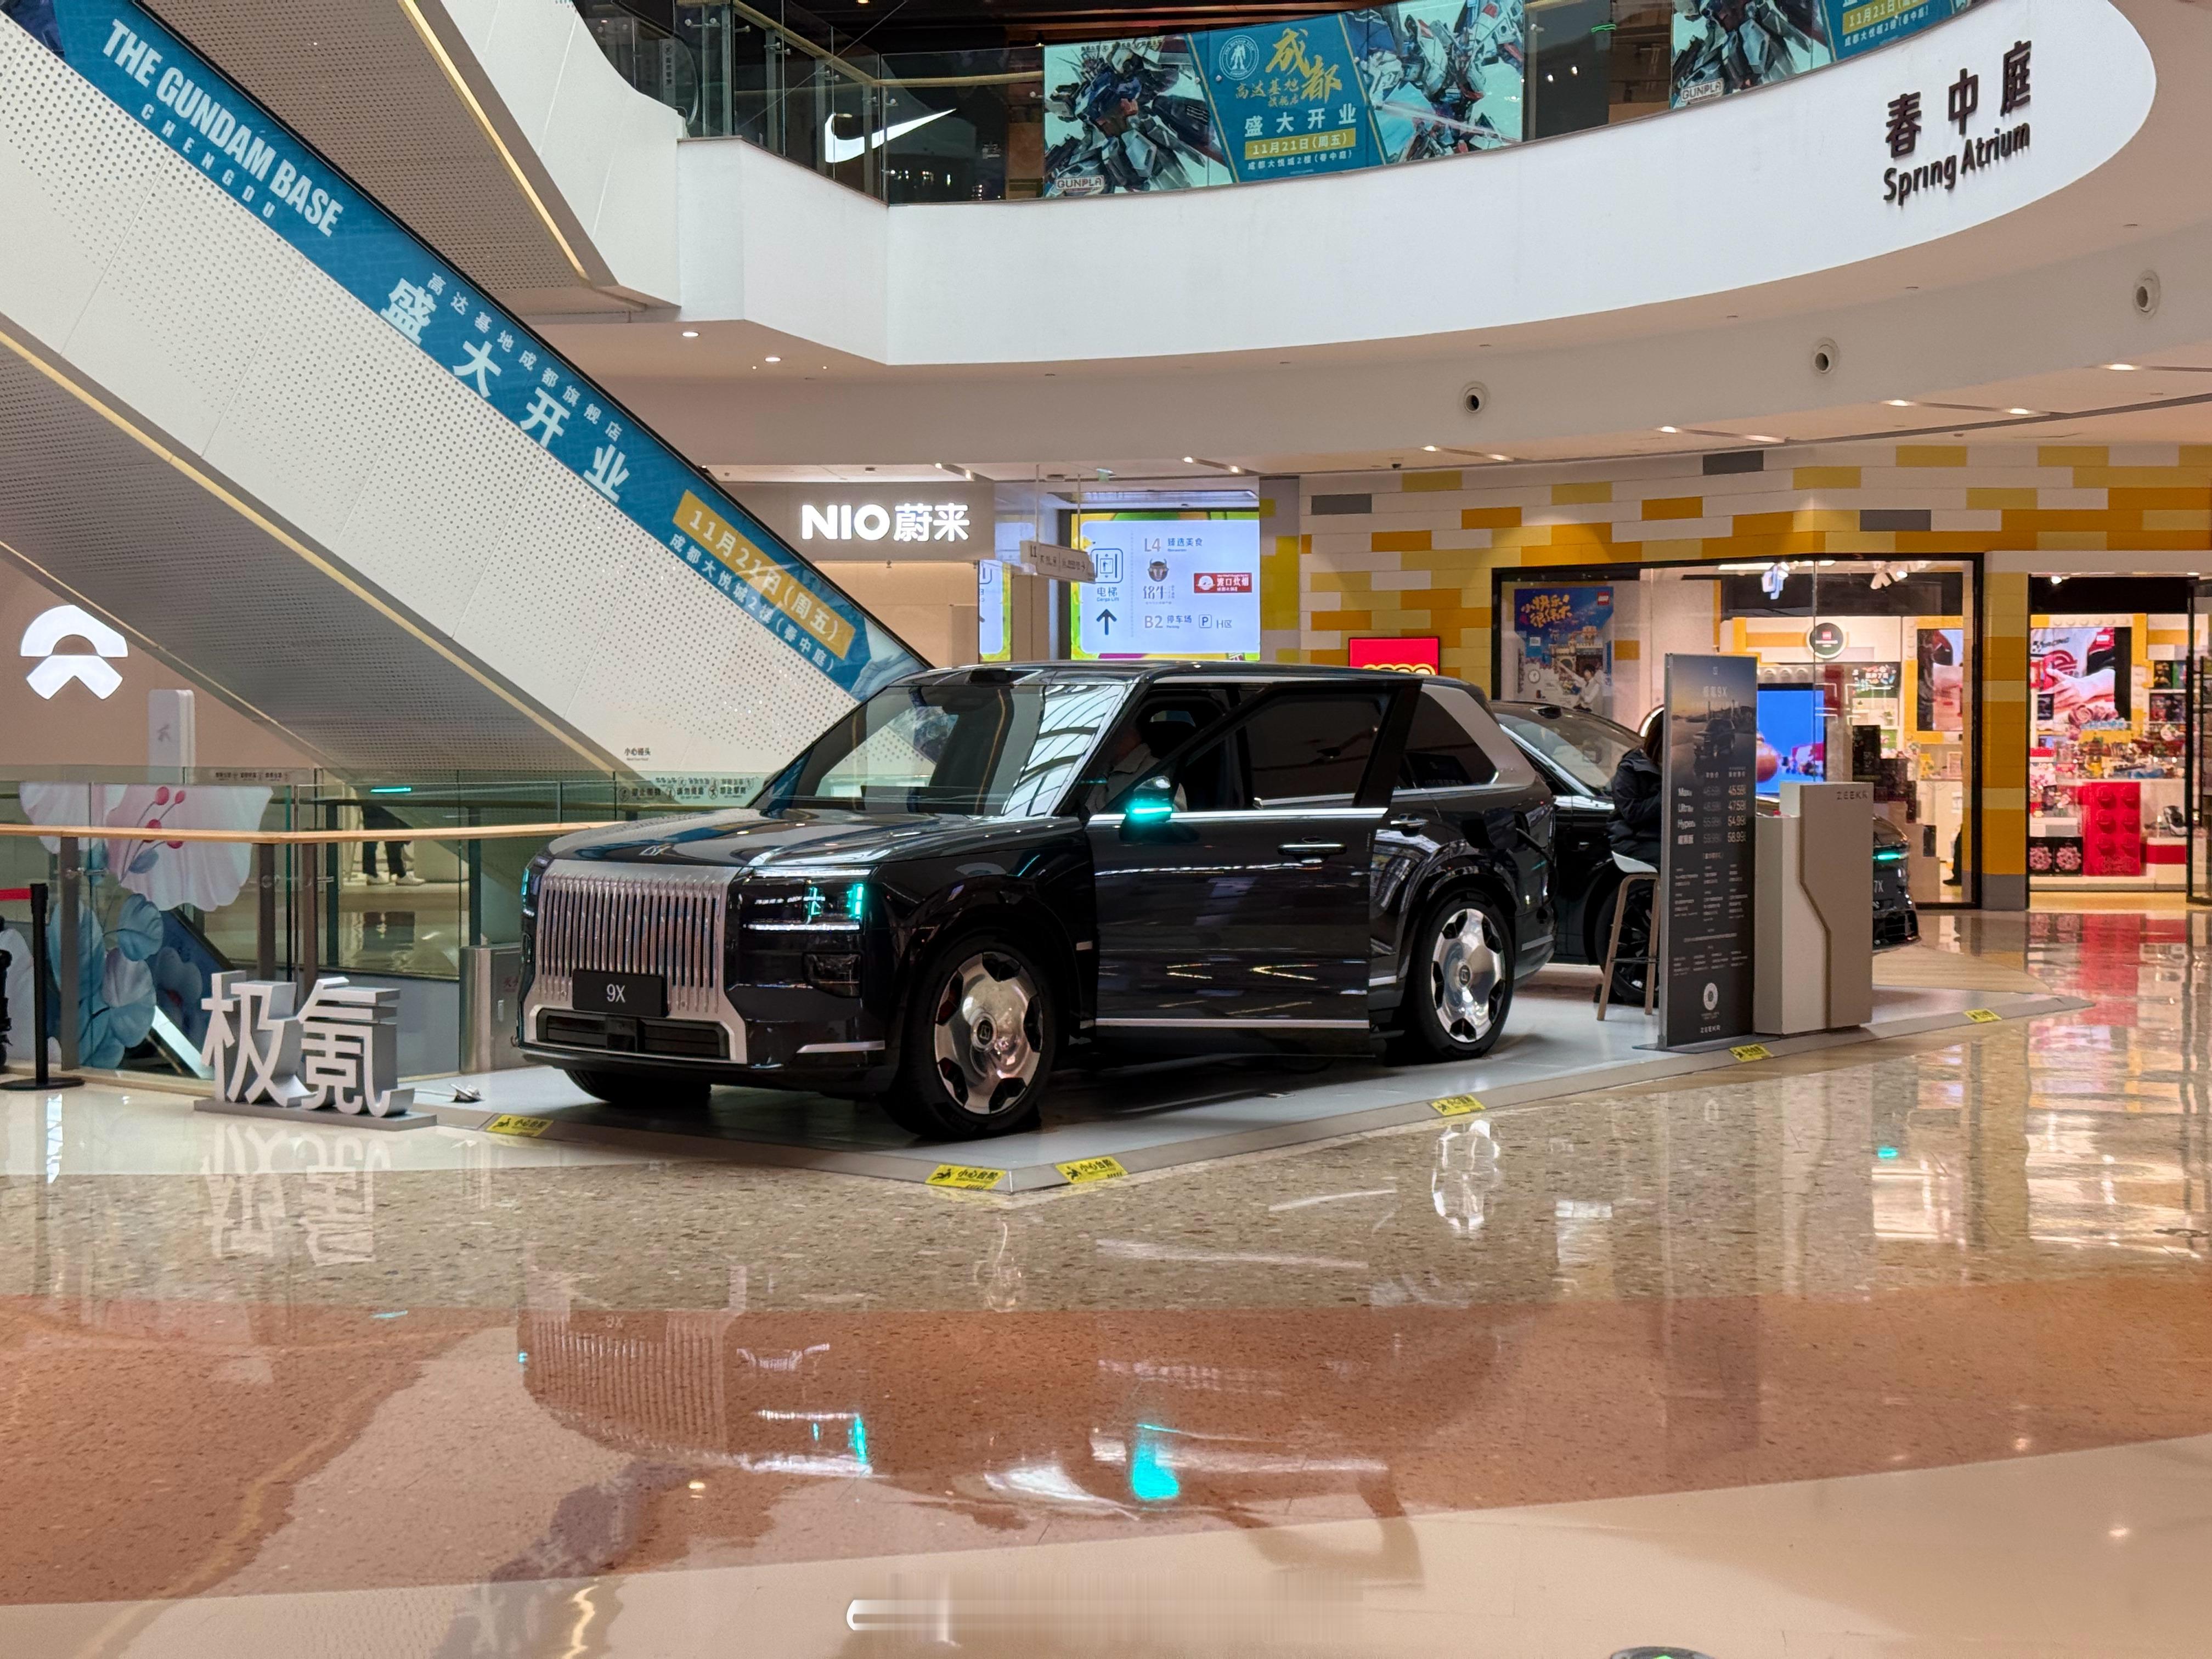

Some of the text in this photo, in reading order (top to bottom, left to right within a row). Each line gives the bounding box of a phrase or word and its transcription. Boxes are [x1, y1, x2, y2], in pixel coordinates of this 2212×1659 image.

[1265, 27, 1343, 104] 成都
[1236, 77, 1300, 99] 高达基地
[1682, 81, 1722, 100] GUNPLA
[1885, 40, 2032, 159] 春中庭
[103, 18, 344, 238] THE GUNDAM BASE
[1244, 103, 1357, 137] 盛大开业
[1252, 132, 1347, 155] 11月21日（周五）
[140, 103, 275, 219] CHENGDU
[1882, 122, 2031, 206] Spring Atrium
[1057, 177, 1102, 188] GUNPLA
[427, 273, 623, 442] 高达基地成都旗舰店
[380, 277, 631, 504] 盛大开业
[801, 502, 971, 542] NIO 蔚来
[1144, 538, 1161, 552] L4
[689, 510, 839, 641] 11月21日（周五）
[1097, 587, 1118, 597] 电梯
[1144, 614, 1192, 629] B2 停车场
[1216, 619, 1233, 629] H区
[1836, 791, 1868, 800] ZEEKR
[606, 984, 626, 1003] 9X
[1700, 1025, 1721, 1034] ZEEKR
[201, 970, 415, 1119] 极氪
